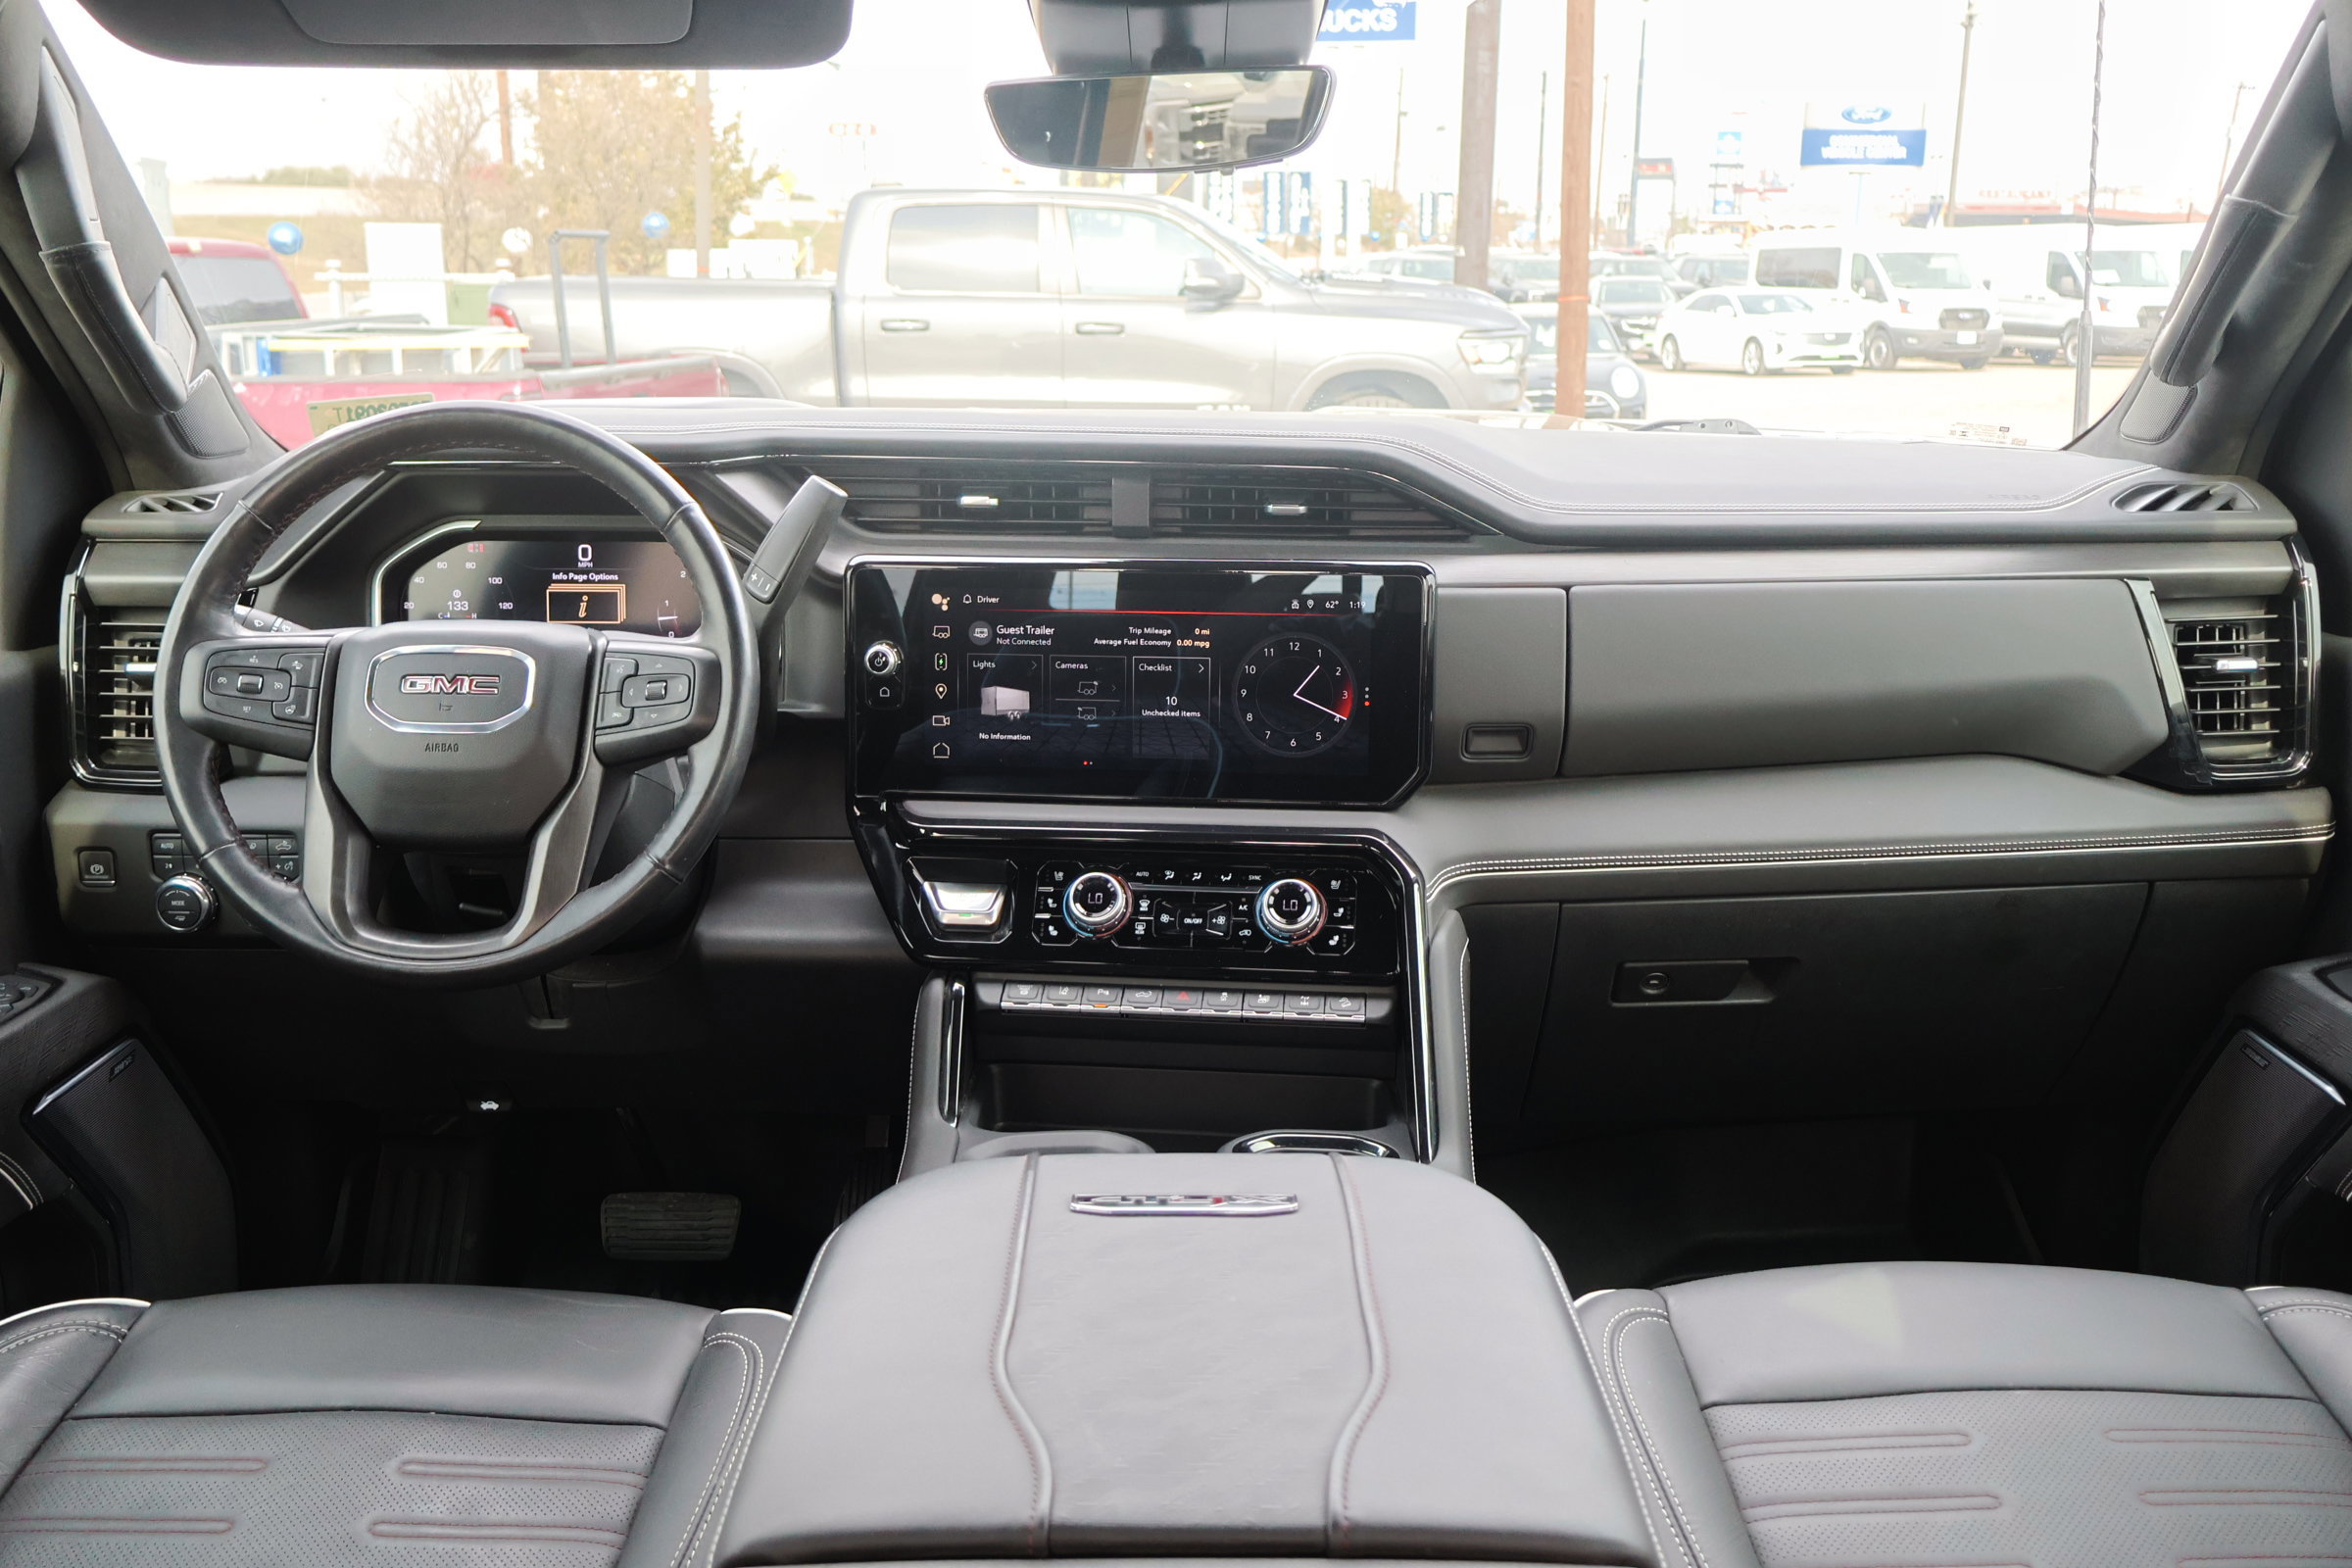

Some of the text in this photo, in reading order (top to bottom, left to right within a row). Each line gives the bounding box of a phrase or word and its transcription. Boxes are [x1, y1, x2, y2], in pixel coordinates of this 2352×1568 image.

[1319, 8, 1397, 32] UCKS
[578, 544, 592, 561] 0
[568, 573, 587, 582] Page
[589, 573, 618, 582] Options
[977, 595, 1000, 604] Driver
[447, 601, 468, 610] 133
[996, 625, 1054, 636] Guest Trailer
[1129, 628, 1172, 637] Trip Mileage
[1140, 639, 1172, 648] Economy
[1289, 642, 1300, 651] 12
[1264, 648, 1274, 657] 11
[1318, 649, 1322, 658] 1
[972, 661, 996, 669] Lights
[1055, 662, 1088, 670] Cameras
[1139, 663, 1172, 672] Checklist
[1245, 665, 1256, 674] 10
[1336, 667, 1342, 676] 2
[400, 674, 500, 696] GMC
[1241, 689, 1247, 697] 9
[1342, 691, 1348, 699] 3
[1165, 696, 1178, 706] 10
[1247, 713, 1252, 722] 8
[1265, 731, 1271, 739] 7
[1316, 732, 1322, 741] 5
[1290, 738, 1296, 747] 6
[424, 742, 460, 754] AIRBAG
[1088, 893, 1103, 905] LO
[1283, 899, 1298, 911] LO
